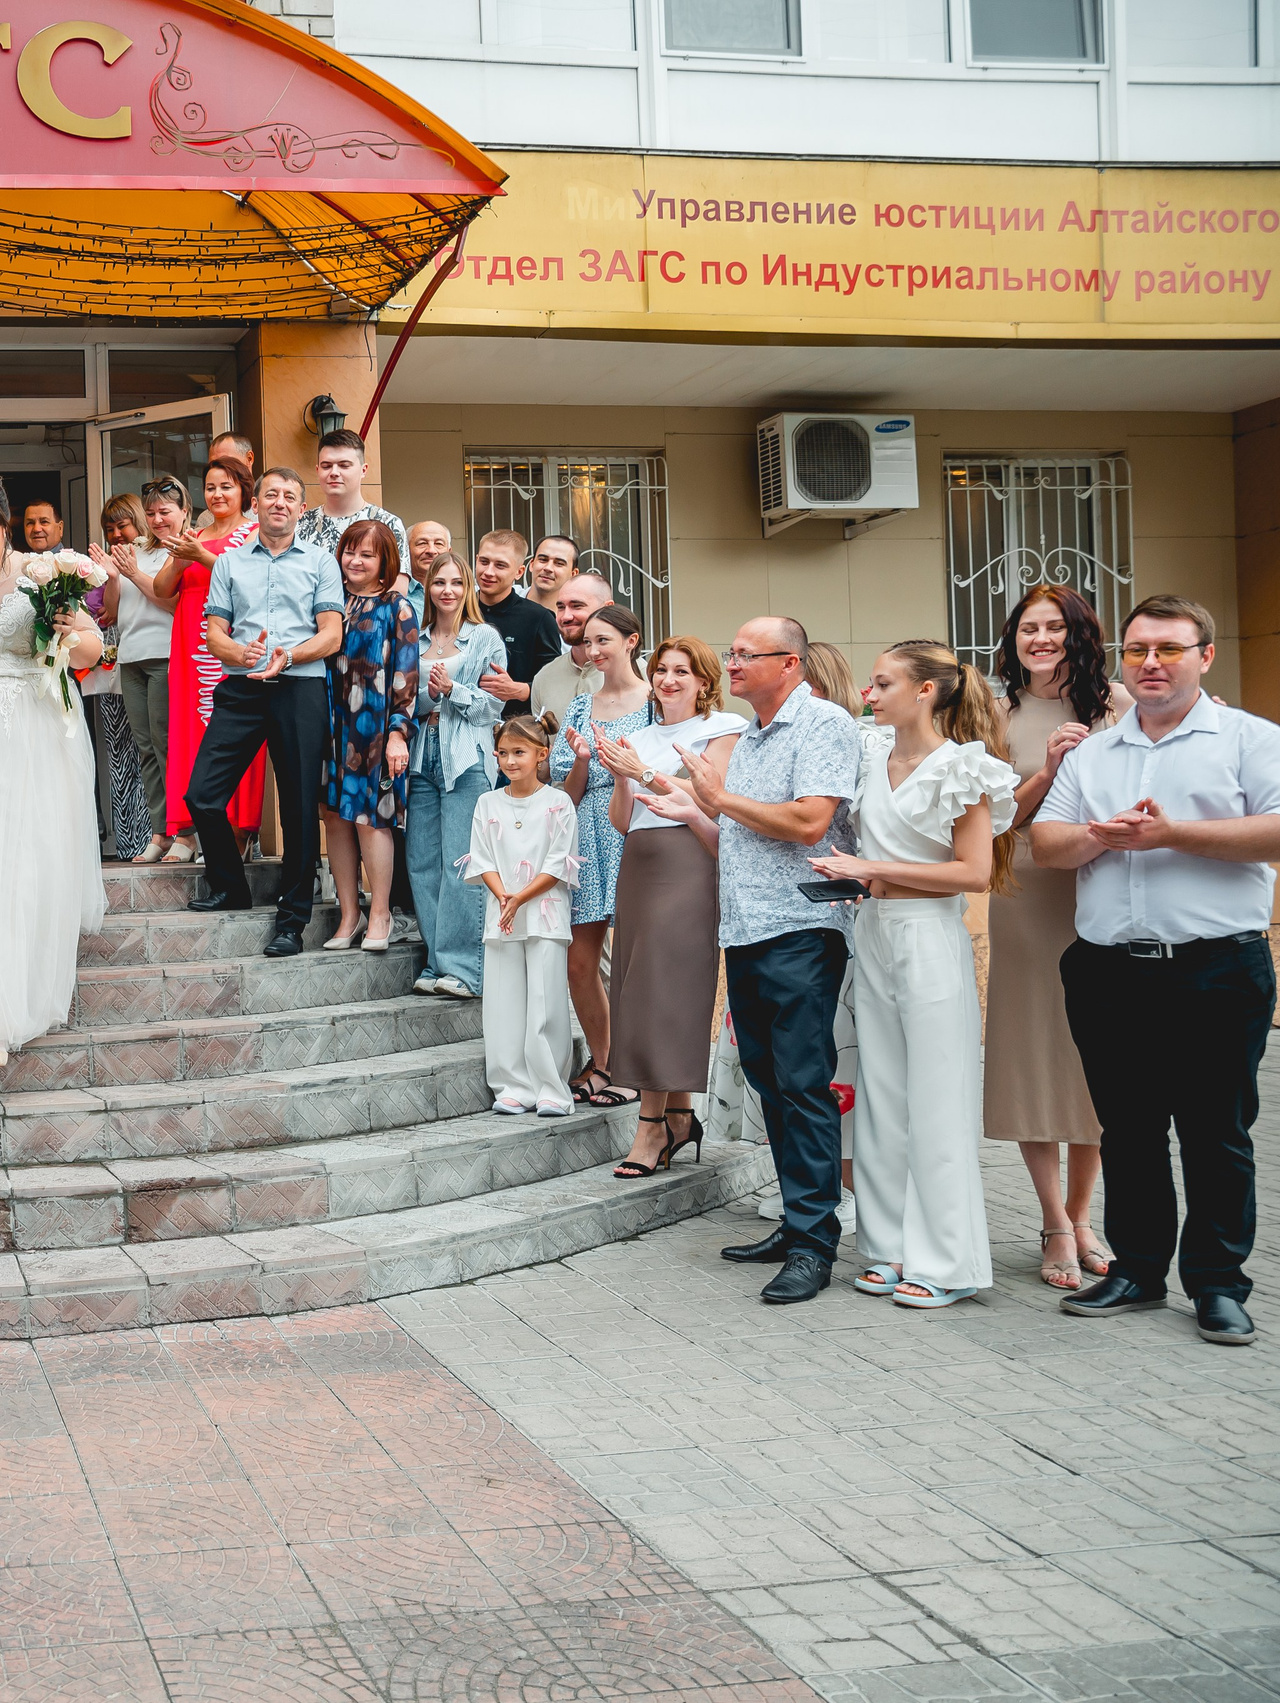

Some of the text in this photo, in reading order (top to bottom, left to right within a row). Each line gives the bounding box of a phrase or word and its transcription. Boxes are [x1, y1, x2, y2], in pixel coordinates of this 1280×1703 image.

[632, 188, 1279, 236] Управление юстиции Алтайского
[434, 246, 1272, 302] Отдел ЗАГС по Индустриальному району
